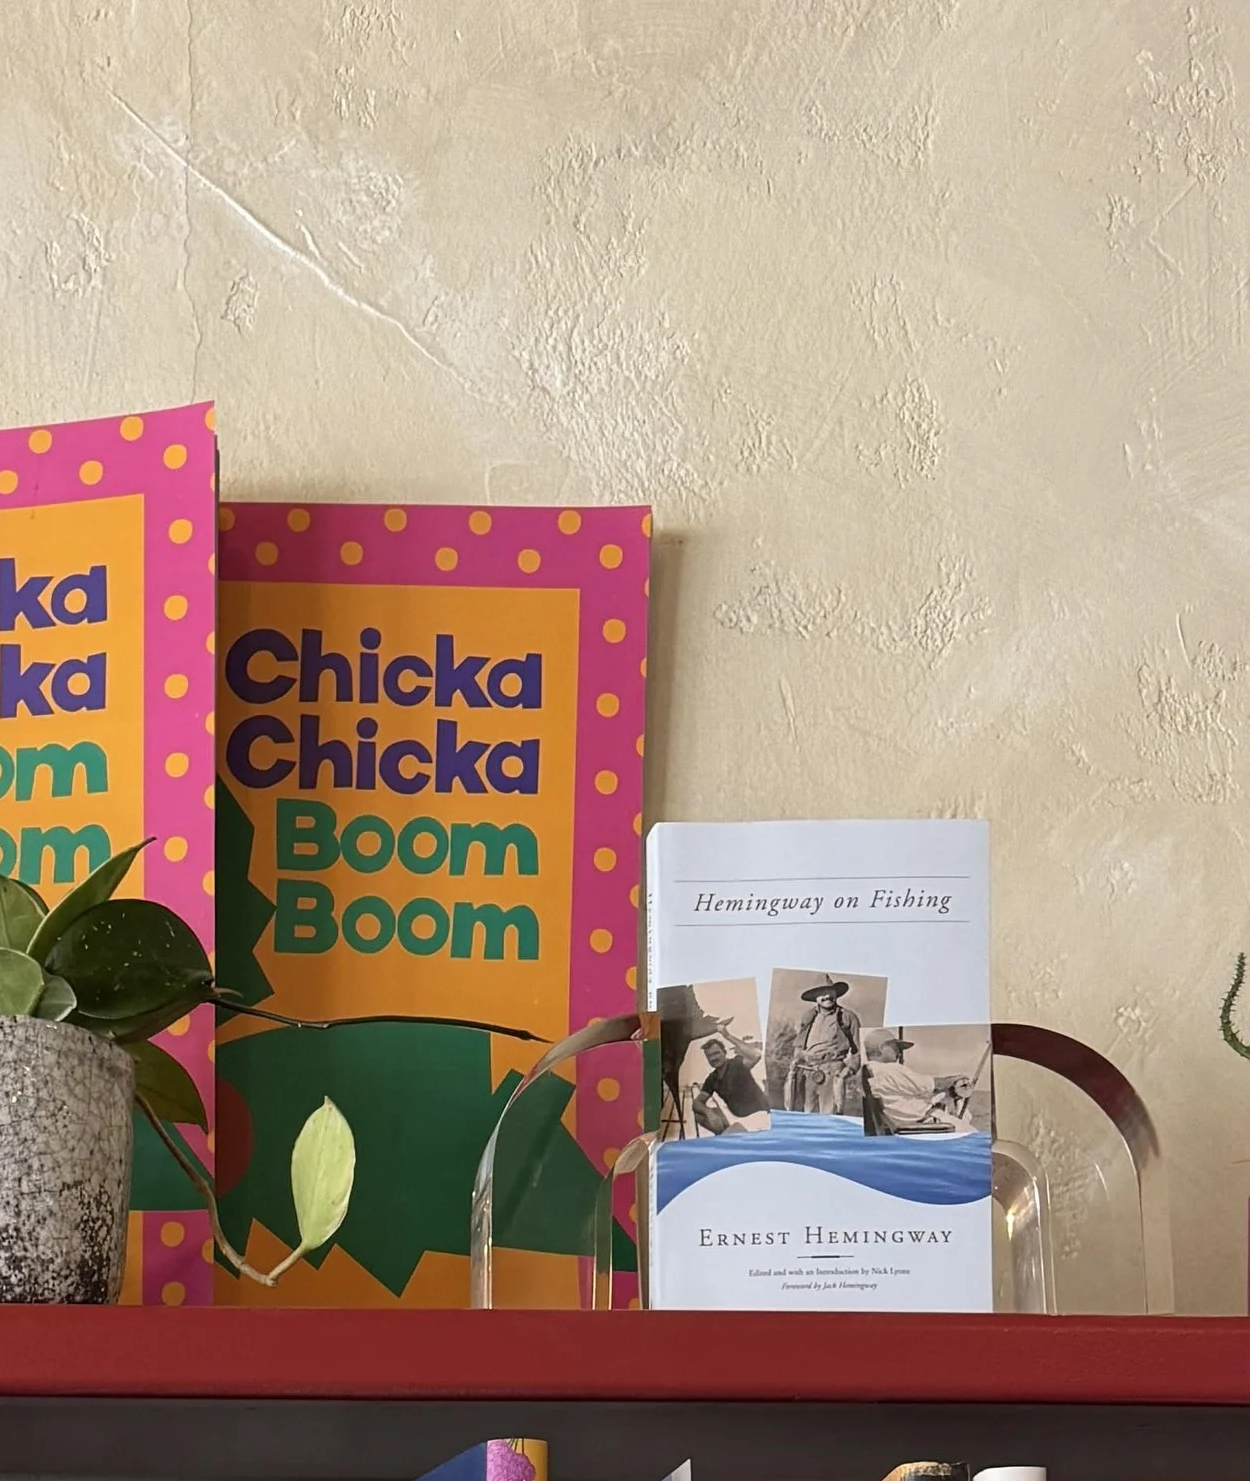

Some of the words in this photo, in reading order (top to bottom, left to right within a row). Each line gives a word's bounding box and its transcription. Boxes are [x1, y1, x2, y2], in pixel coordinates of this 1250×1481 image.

[225, 628, 543, 710] Chicka
[226, 715, 541, 796] Chicka
[276, 798, 539, 875] Boom
[273, 878, 540, 960] Boom
[694, 890, 824, 916] Hemingway
[834, 893, 860, 911] on
[870, 888, 952, 915] Fishing
